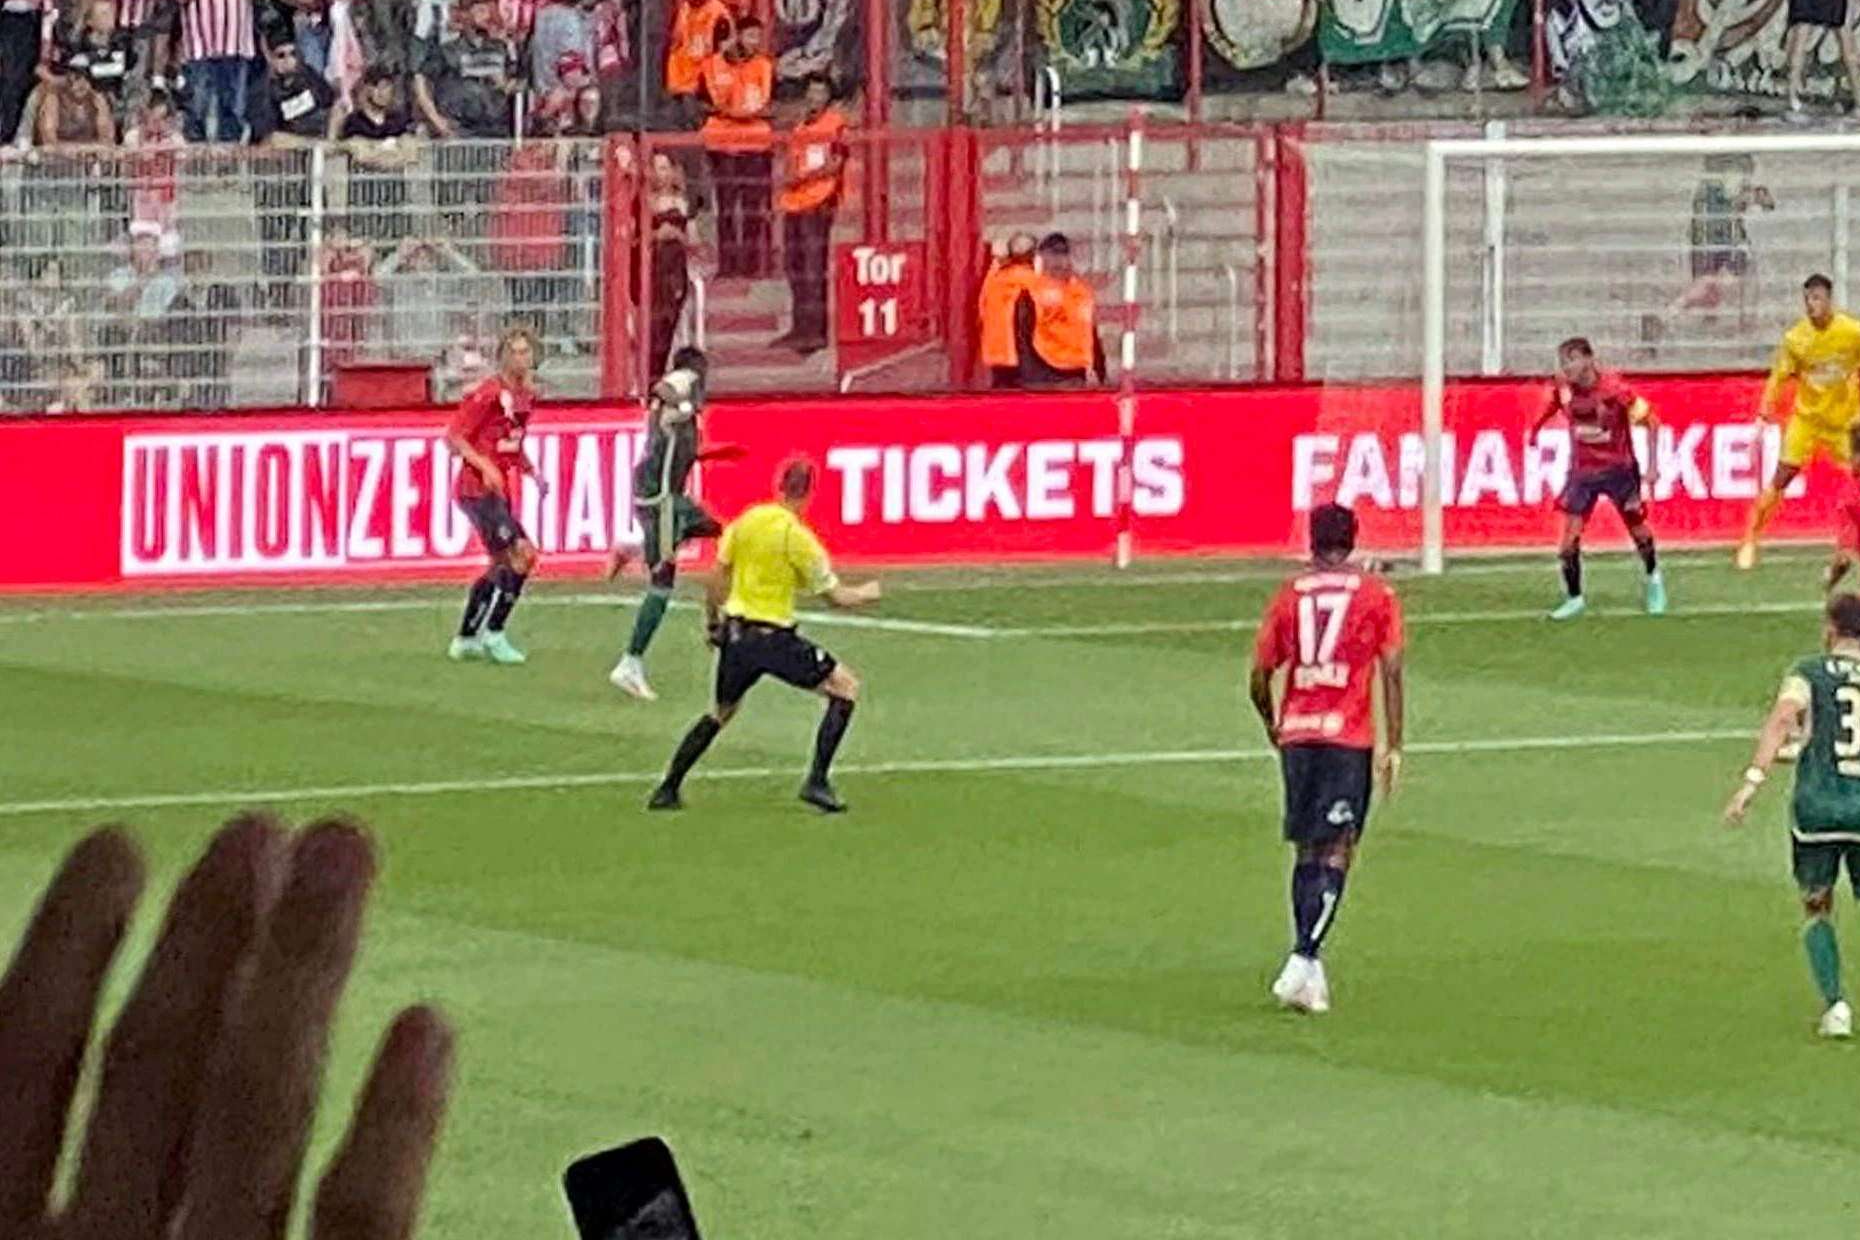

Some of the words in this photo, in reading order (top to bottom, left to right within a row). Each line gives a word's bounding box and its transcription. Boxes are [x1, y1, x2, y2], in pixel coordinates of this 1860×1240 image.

[853, 246, 907, 284] Tor
[858, 298, 897, 337] 11
[825, 436, 1185, 525] TICKETS
[1298, 592, 1352, 666] 17
